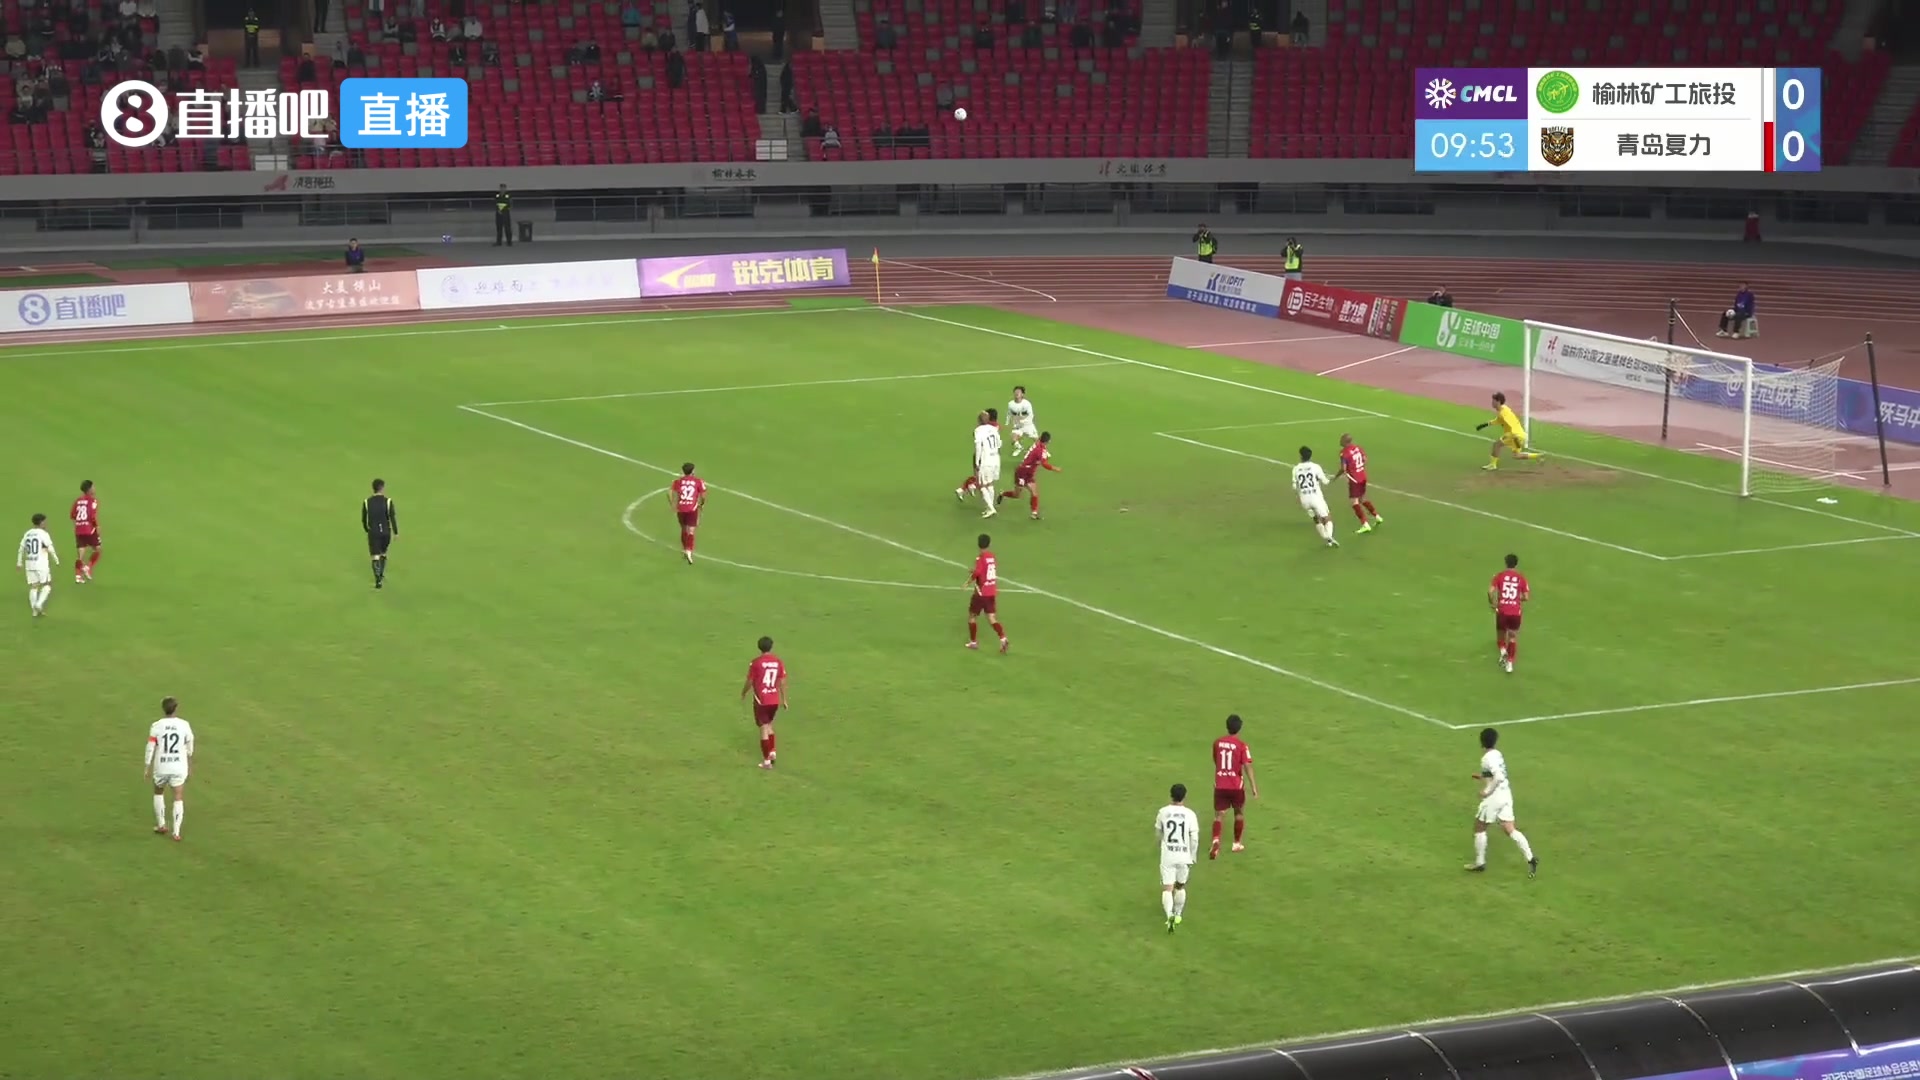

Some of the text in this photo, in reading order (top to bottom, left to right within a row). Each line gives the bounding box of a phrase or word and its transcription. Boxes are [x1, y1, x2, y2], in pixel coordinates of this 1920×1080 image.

[732, 256, 834, 286] 锐克体育
[55, 293, 127, 321] 直播吧
[1302, 291, 1335, 312] 巨子生物
[1461, 318, 1501, 340] 足球中国
[986, 434, 997, 450] 17
[1298, 472, 1315, 490] 23
[680, 485, 695, 501] 32
[76, 505, 88, 522] 28
[24, 538, 40, 555] 60
[1501, 581, 1519, 600] 55
[762, 668, 778, 687] 47
[161, 733, 180, 754] 12
[1219, 749, 1234, 770] 11
[1165, 819, 1186, 844] 21
